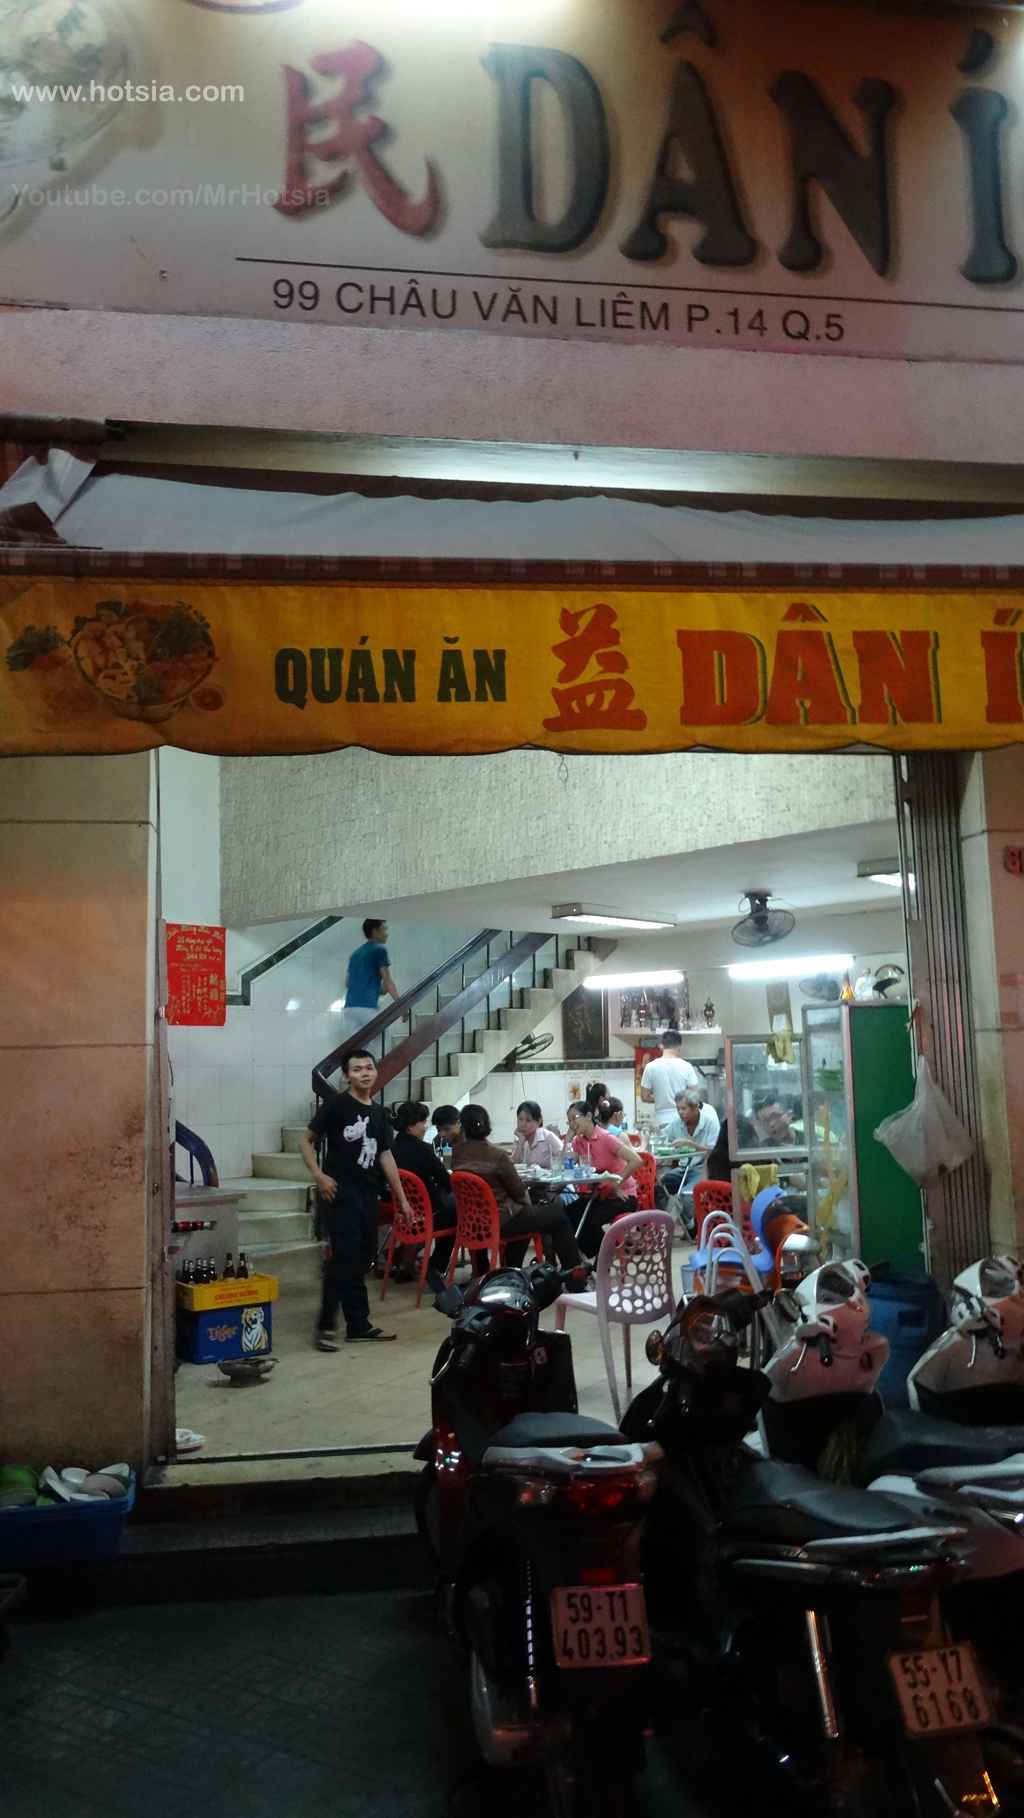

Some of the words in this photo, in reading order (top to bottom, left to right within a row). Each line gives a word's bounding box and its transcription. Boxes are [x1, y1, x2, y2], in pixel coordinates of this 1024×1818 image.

[272, 40, 442, 237] 民
[477, 0, 896, 278] DÂN
[272, 278, 320, 311] 99
[335, 278, 458, 320] CHÂU
[472, 285, 558, 326] VĂN
[574, 290, 671, 332] LIÊM
[686, 303, 768, 338] P.14
[781, 308, 846, 342] Q.5
[274, 635, 417, 711] QUÁN
[436, 635, 508, 703] ĂN
[542, 603, 649, 733] 益
[676, 602, 943, 727] DÂN
[566, 1590, 629, 1624] 59-T1
[561, 1625, 644, 1661] 403.93
[912, 1686, 980, 1729] 6168
